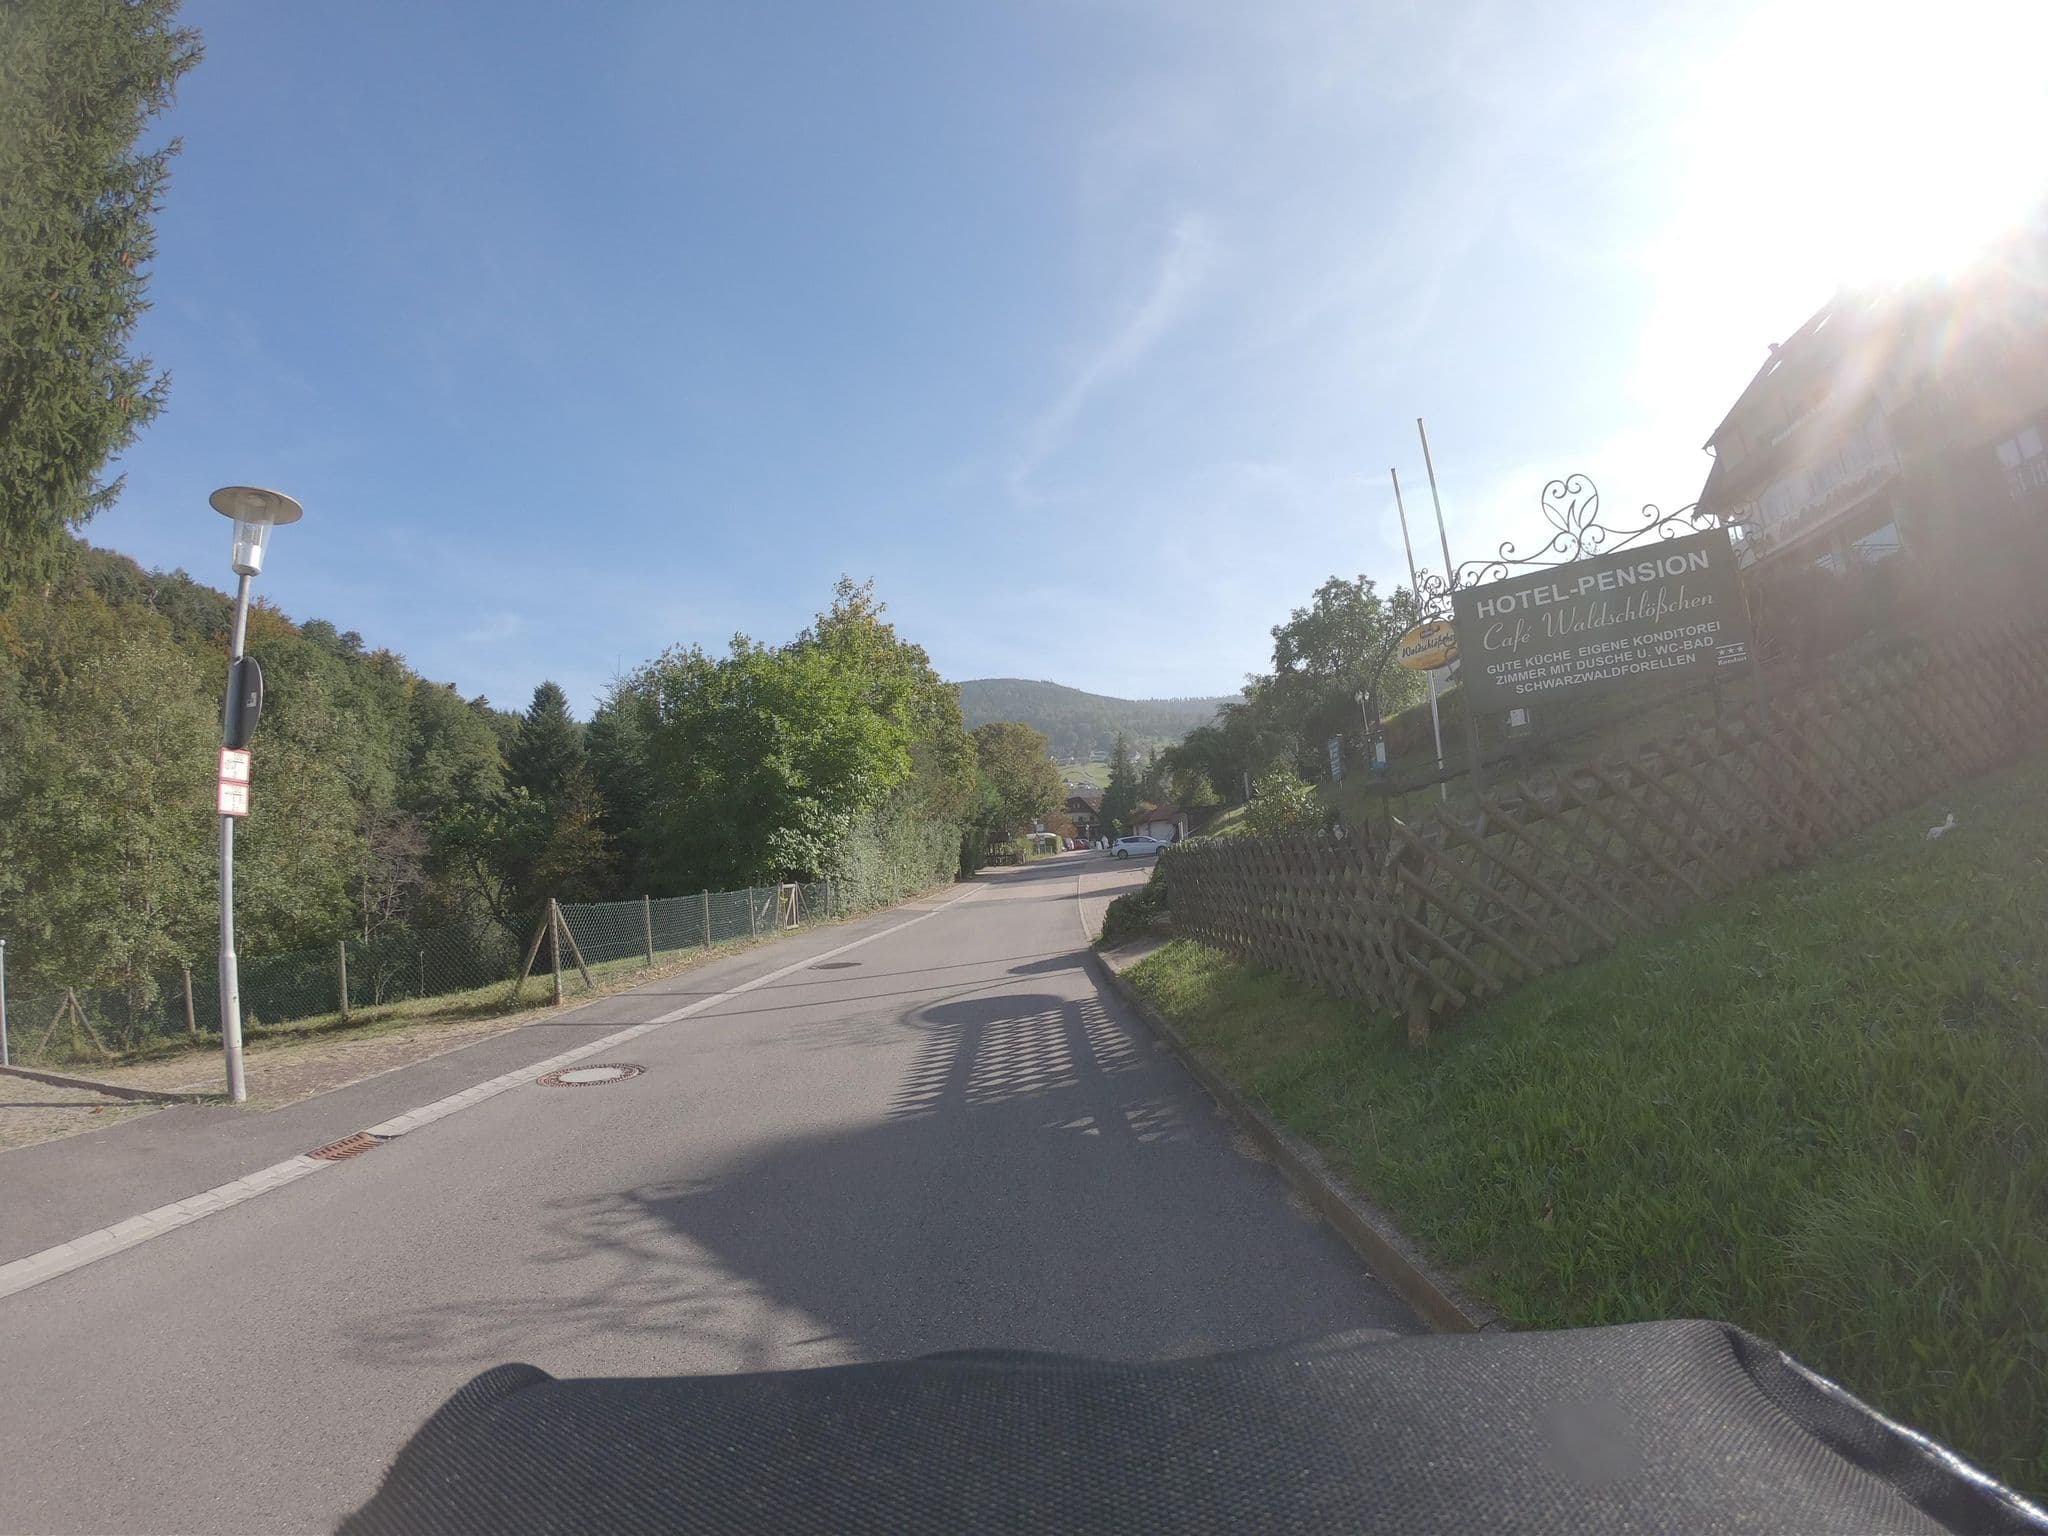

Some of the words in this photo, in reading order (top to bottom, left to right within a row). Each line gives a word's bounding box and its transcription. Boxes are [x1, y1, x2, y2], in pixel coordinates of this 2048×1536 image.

[1476, 549, 1709, 619] HOTEL-PENSION
[1483, 618, 1532, 653] Café
[1542, 585, 1713, 638] Waldschlößchen
[1486, 660, 1522, 675] GUTE
[1525, 650, 1571, 668] KÜCHE
[1578, 638, 1630, 657] EIGENE
[1633, 621, 1721, 647] KONDITOREI
[1495, 668, 1547, 685] ZIMMER
[1550, 662, 1573, 675] MIT
[1576, 651, 1633, 671] DUSCHE
[1636, 648, 1652, 659] U.
[1655, 636, 1714, 656] WC-BAD
[1515, 652, 1696, 694] SCHWARZWALDFORELLEN
